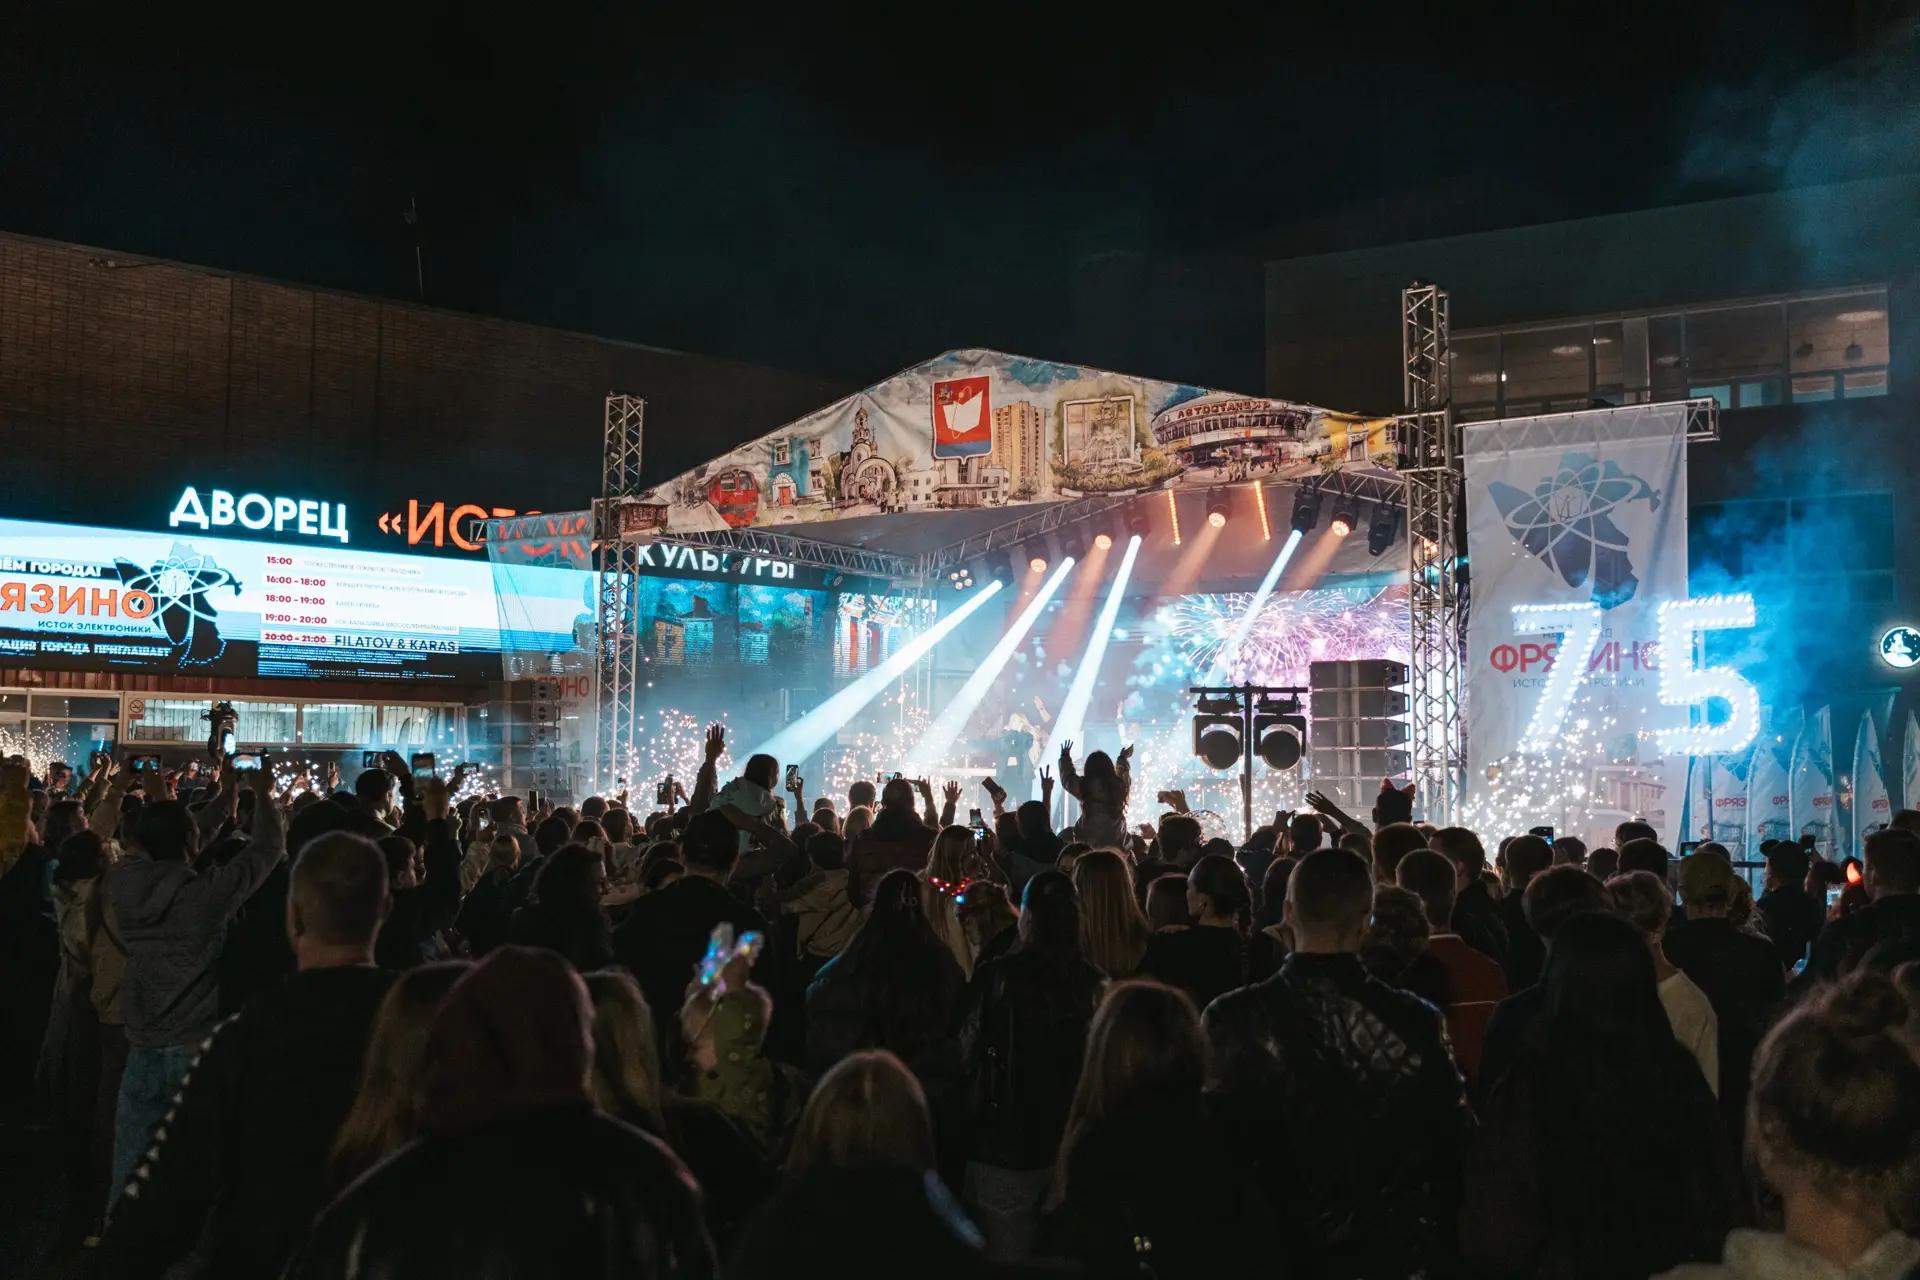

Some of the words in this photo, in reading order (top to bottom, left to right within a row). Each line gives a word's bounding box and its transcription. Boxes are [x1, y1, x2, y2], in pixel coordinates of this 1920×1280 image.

[169, 485, 349, 544] ДВОРЕЦ
[0, 556, 27, 571] ЁМ
[30, 561, 102, 577] ГОРОДА!
[267, 556, 293, 566] 15:00
[266, 575, 292, 585] 16:00
[300, 577, 326, 587] 18:00
[0, 581, 155, 619] ЯЗИНО
[265, 594, 292, 603] 18:00
[300, 596, 326, 605] 19:00
[264, 613, 291, 622] 19:00
[299, 615, 328, 625] 20:00
[38, 620, 74, 630] ИСТОК
[77, 622, 151, 633] ЭЛЕКТРОНИКИ
[264, 633, 293, 642] 20:00
[301, 634, 327, 644] 21:00
[335, 635, 394, 649] FILATOV
[397, 638, 406, 649] &
[410, 638, 456, 652] KARAS
[40, 641, 91, 655] ГОРОДА
[1489, 640, 1662, 673] ФРЯИНО
[1511, 593, 1760, 756] 75
